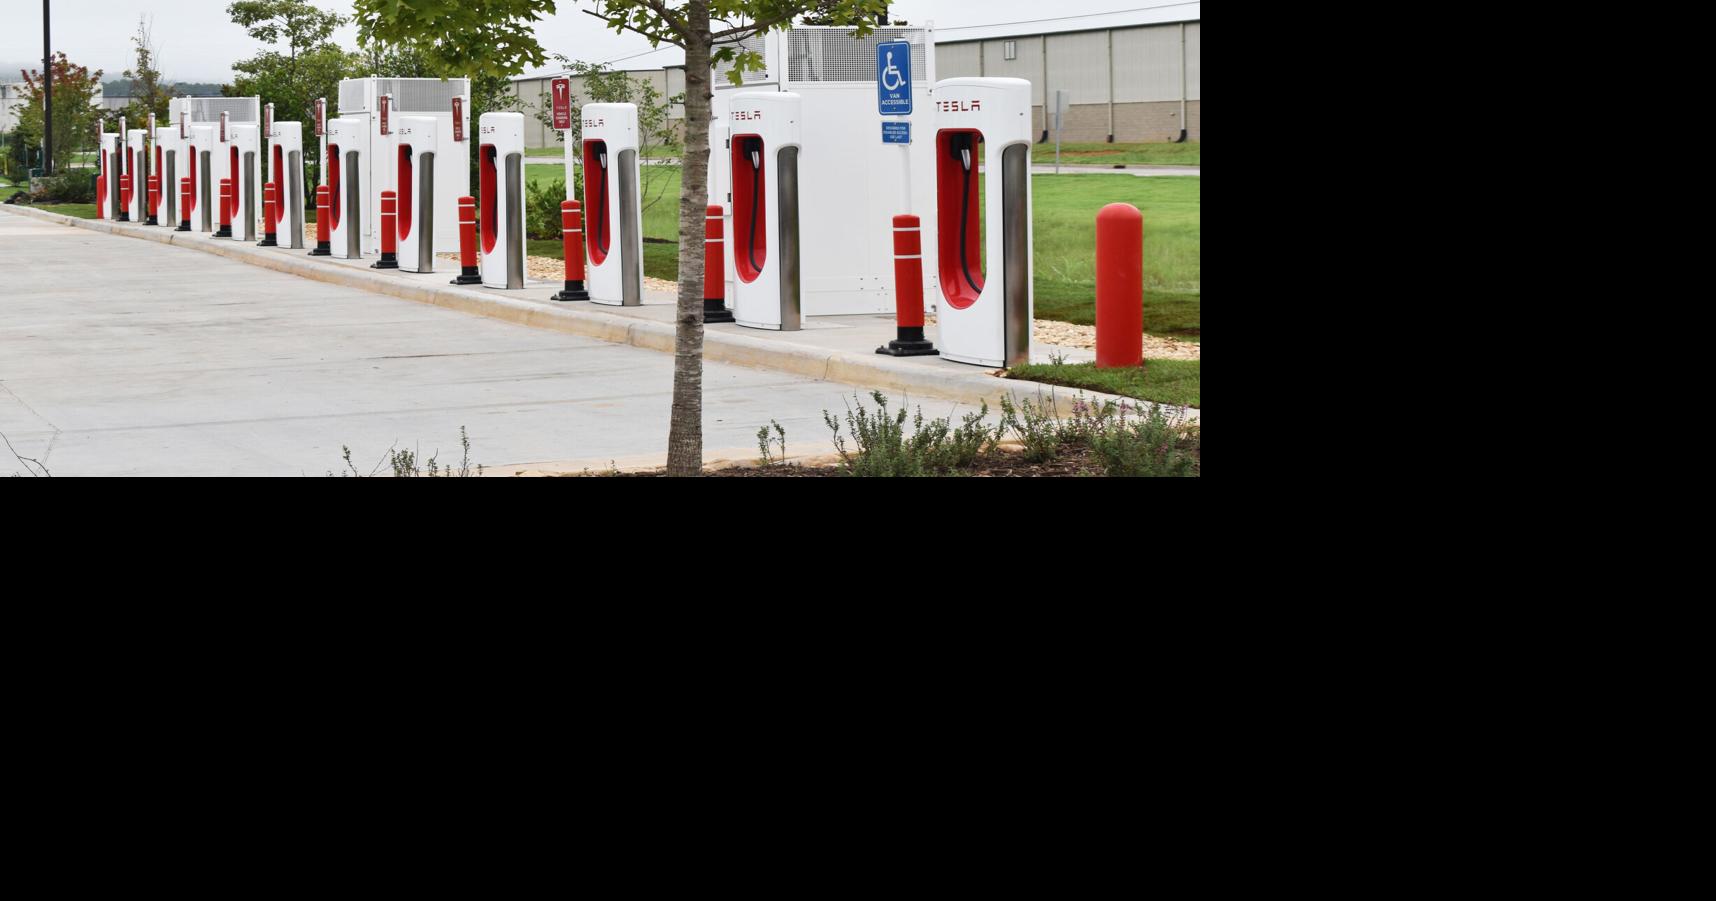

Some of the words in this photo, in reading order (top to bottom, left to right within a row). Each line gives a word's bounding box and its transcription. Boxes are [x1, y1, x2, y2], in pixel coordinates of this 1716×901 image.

[935, 100, 981, 112] TESLA
[730, 110, 761, 121] TESLA
[582, 119, 605, 128] ESLA
